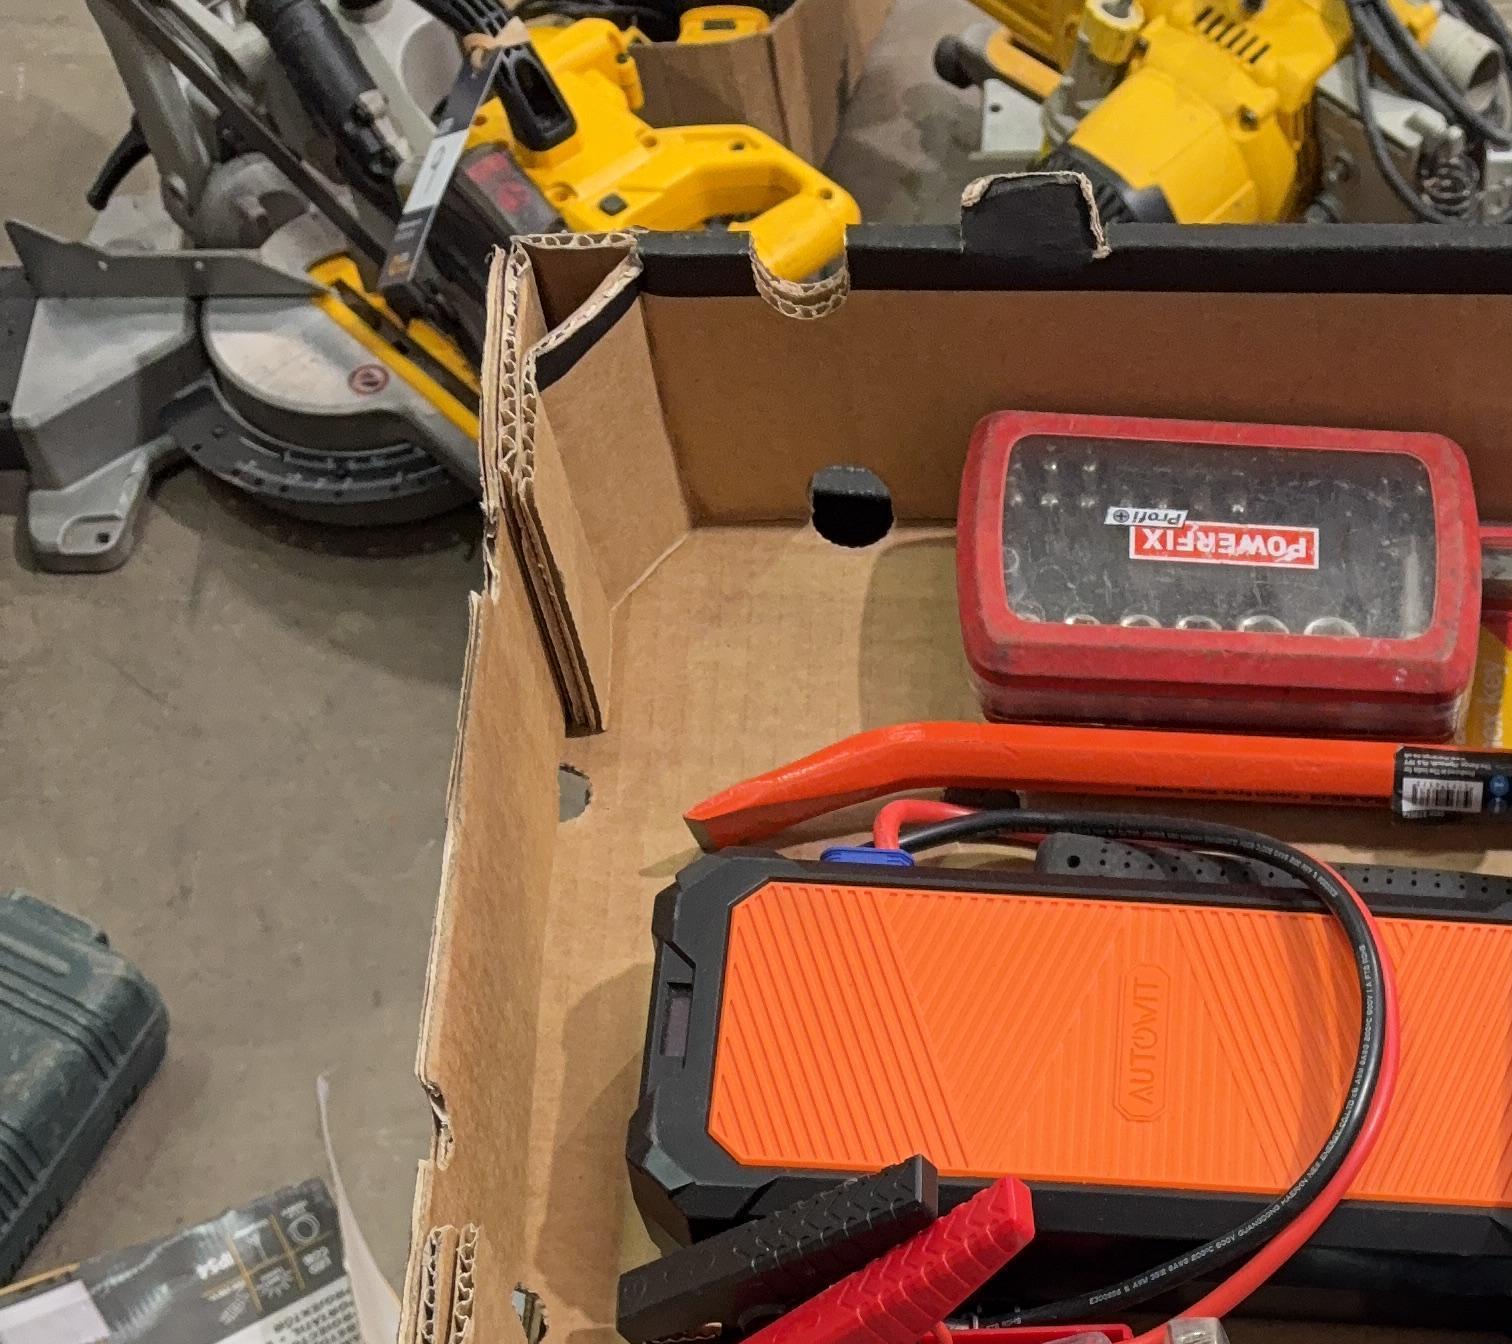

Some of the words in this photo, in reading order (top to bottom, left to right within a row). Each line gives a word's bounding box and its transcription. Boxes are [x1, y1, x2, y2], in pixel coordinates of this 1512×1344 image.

[1132, 509, 1181, 524] Profi
[1143, 527, 1306, 558] POWERFIX
[1128, 976, 1158, 1104] AUTOWIT
